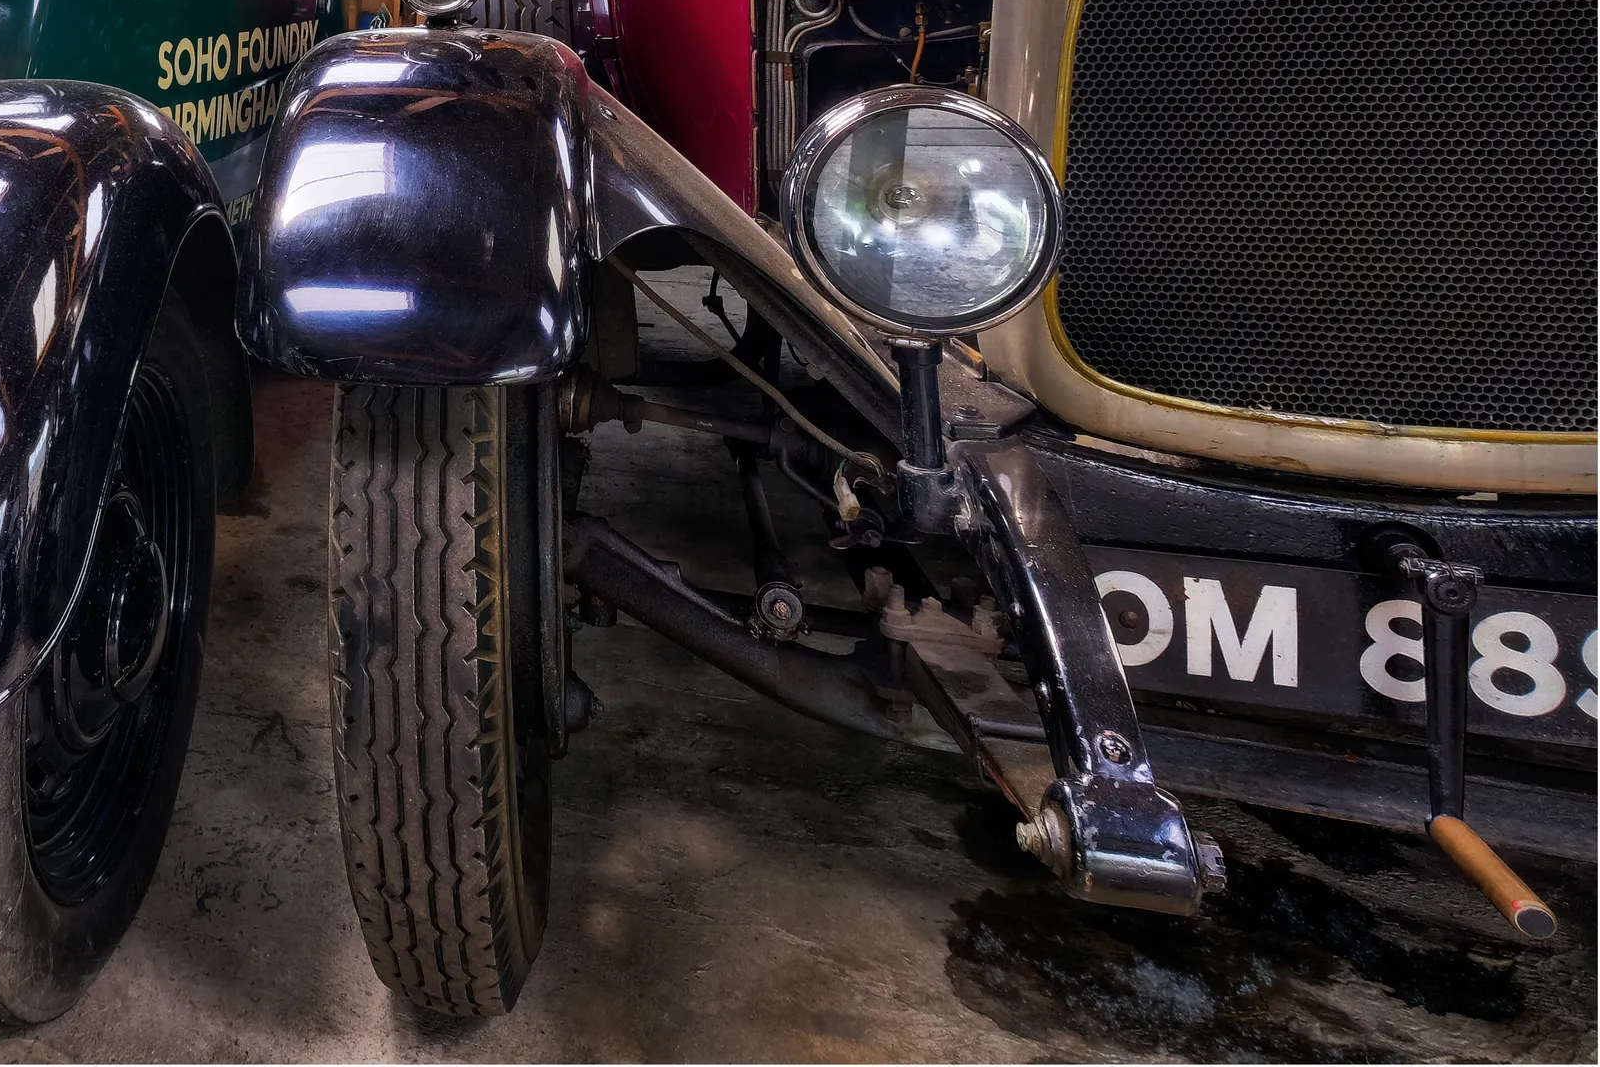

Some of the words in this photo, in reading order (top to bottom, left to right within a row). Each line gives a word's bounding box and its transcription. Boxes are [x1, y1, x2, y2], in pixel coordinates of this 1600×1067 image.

[157, 33, 232, 90] SOHO
[236, 19, 319, 76] FOUNDRY
[158, 81, 284, 145] IRMINGHA
[1093, 569, 1299, 688] OM
[1359, 599, 1598, 720] 88
